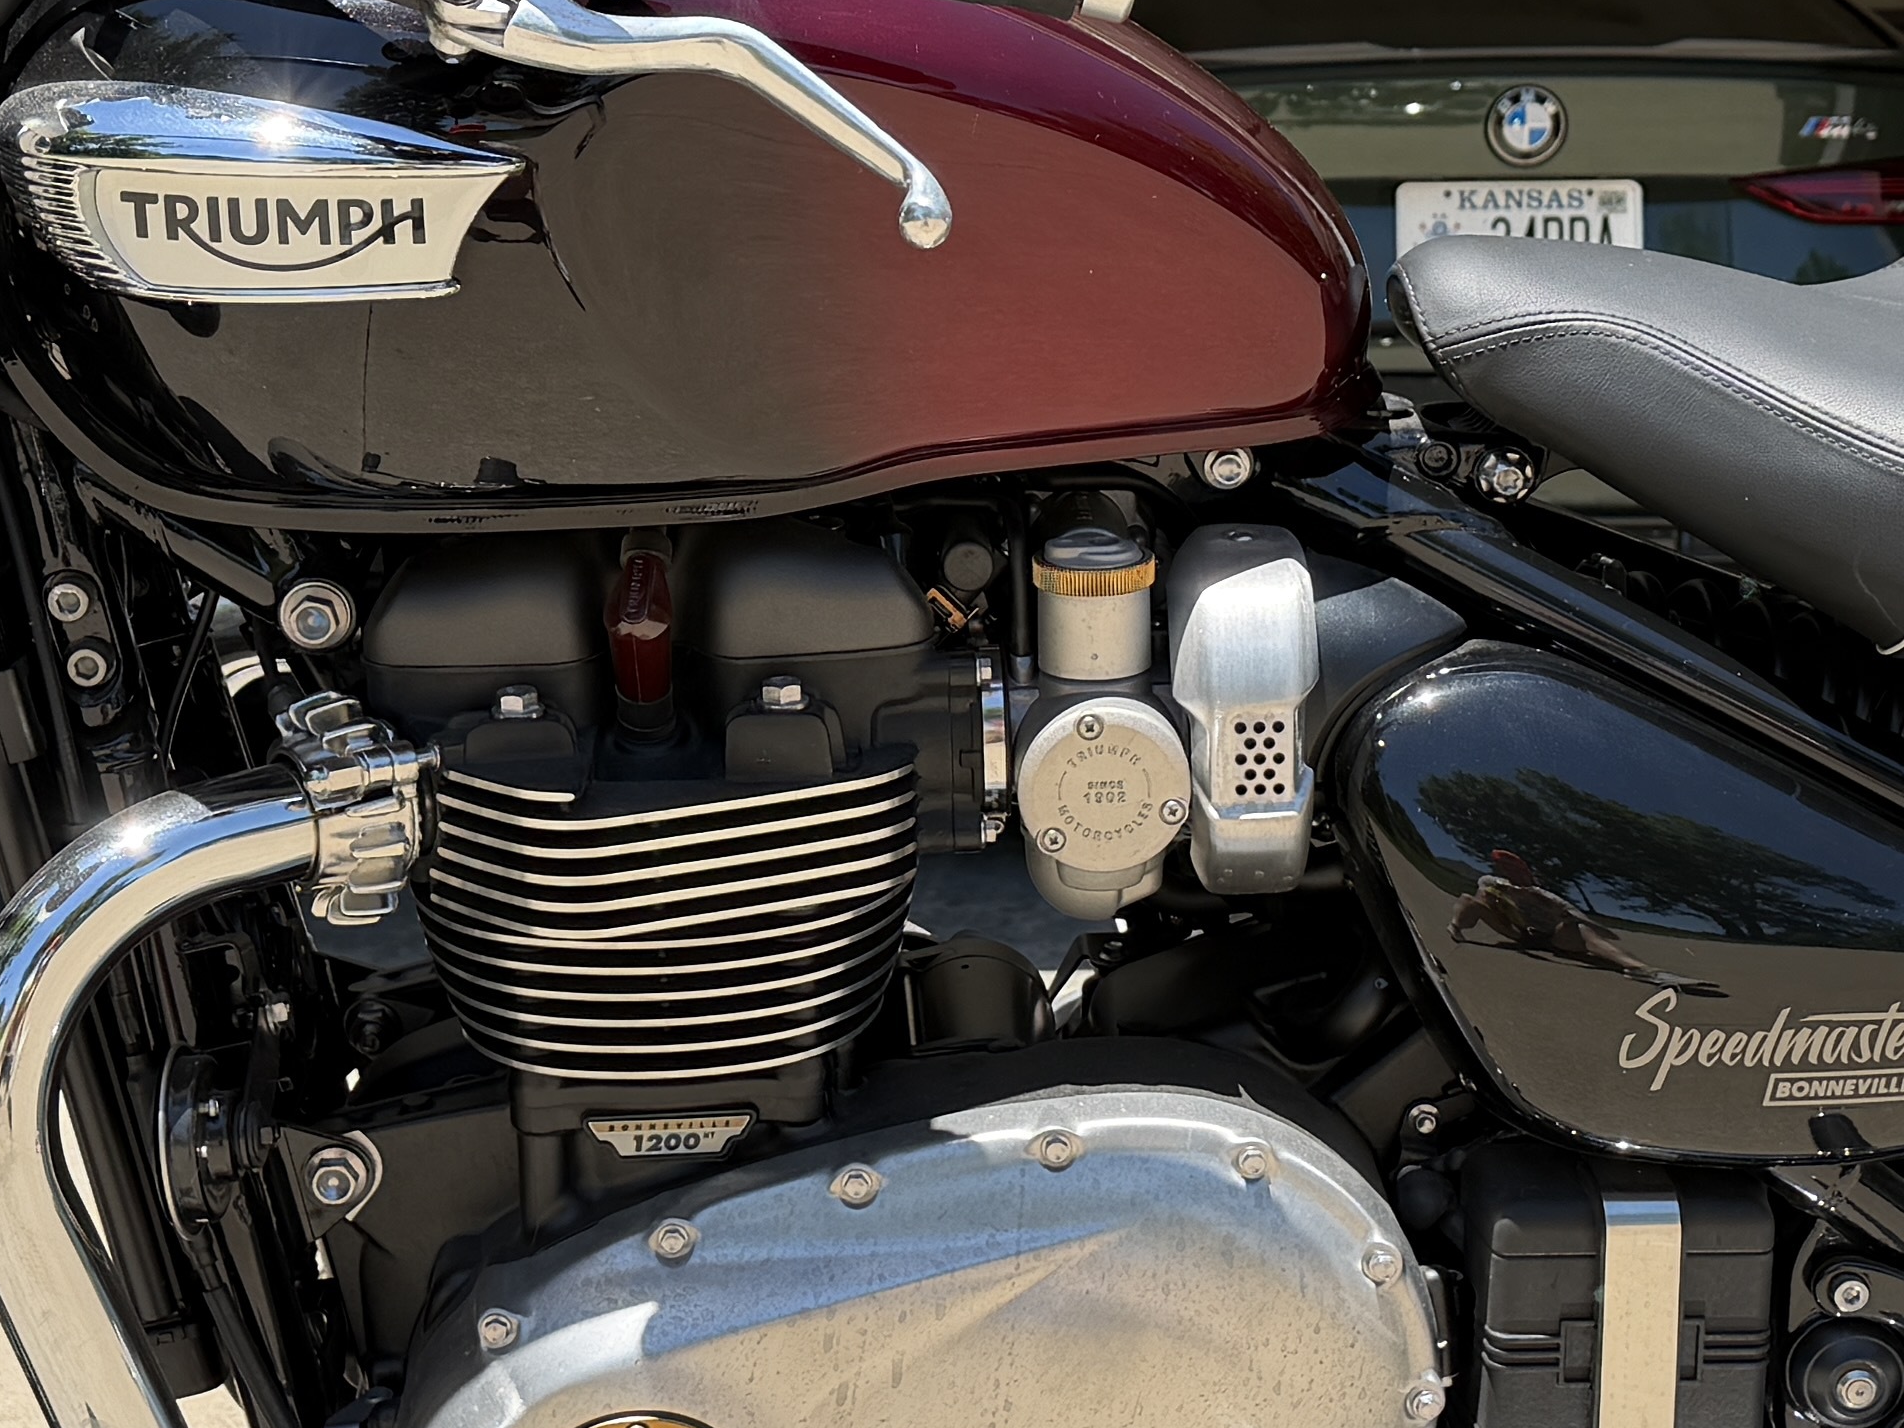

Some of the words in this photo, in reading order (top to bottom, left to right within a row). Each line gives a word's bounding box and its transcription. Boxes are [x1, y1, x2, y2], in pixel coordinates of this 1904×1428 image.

[1457, 188, 1585, 210] KANSAS
[120, 191, 426, 271] TRIUMPH
[1066, 744, 1142, 769] TRIUMPH
[1087, 779, 1124, 790] SINCE
[1083, 791, 1127, 804] 1902
[1058, 801, 1154, 842] MOTORCYCLES
[608, 1120, 730, 1132] BONNEVILLE
